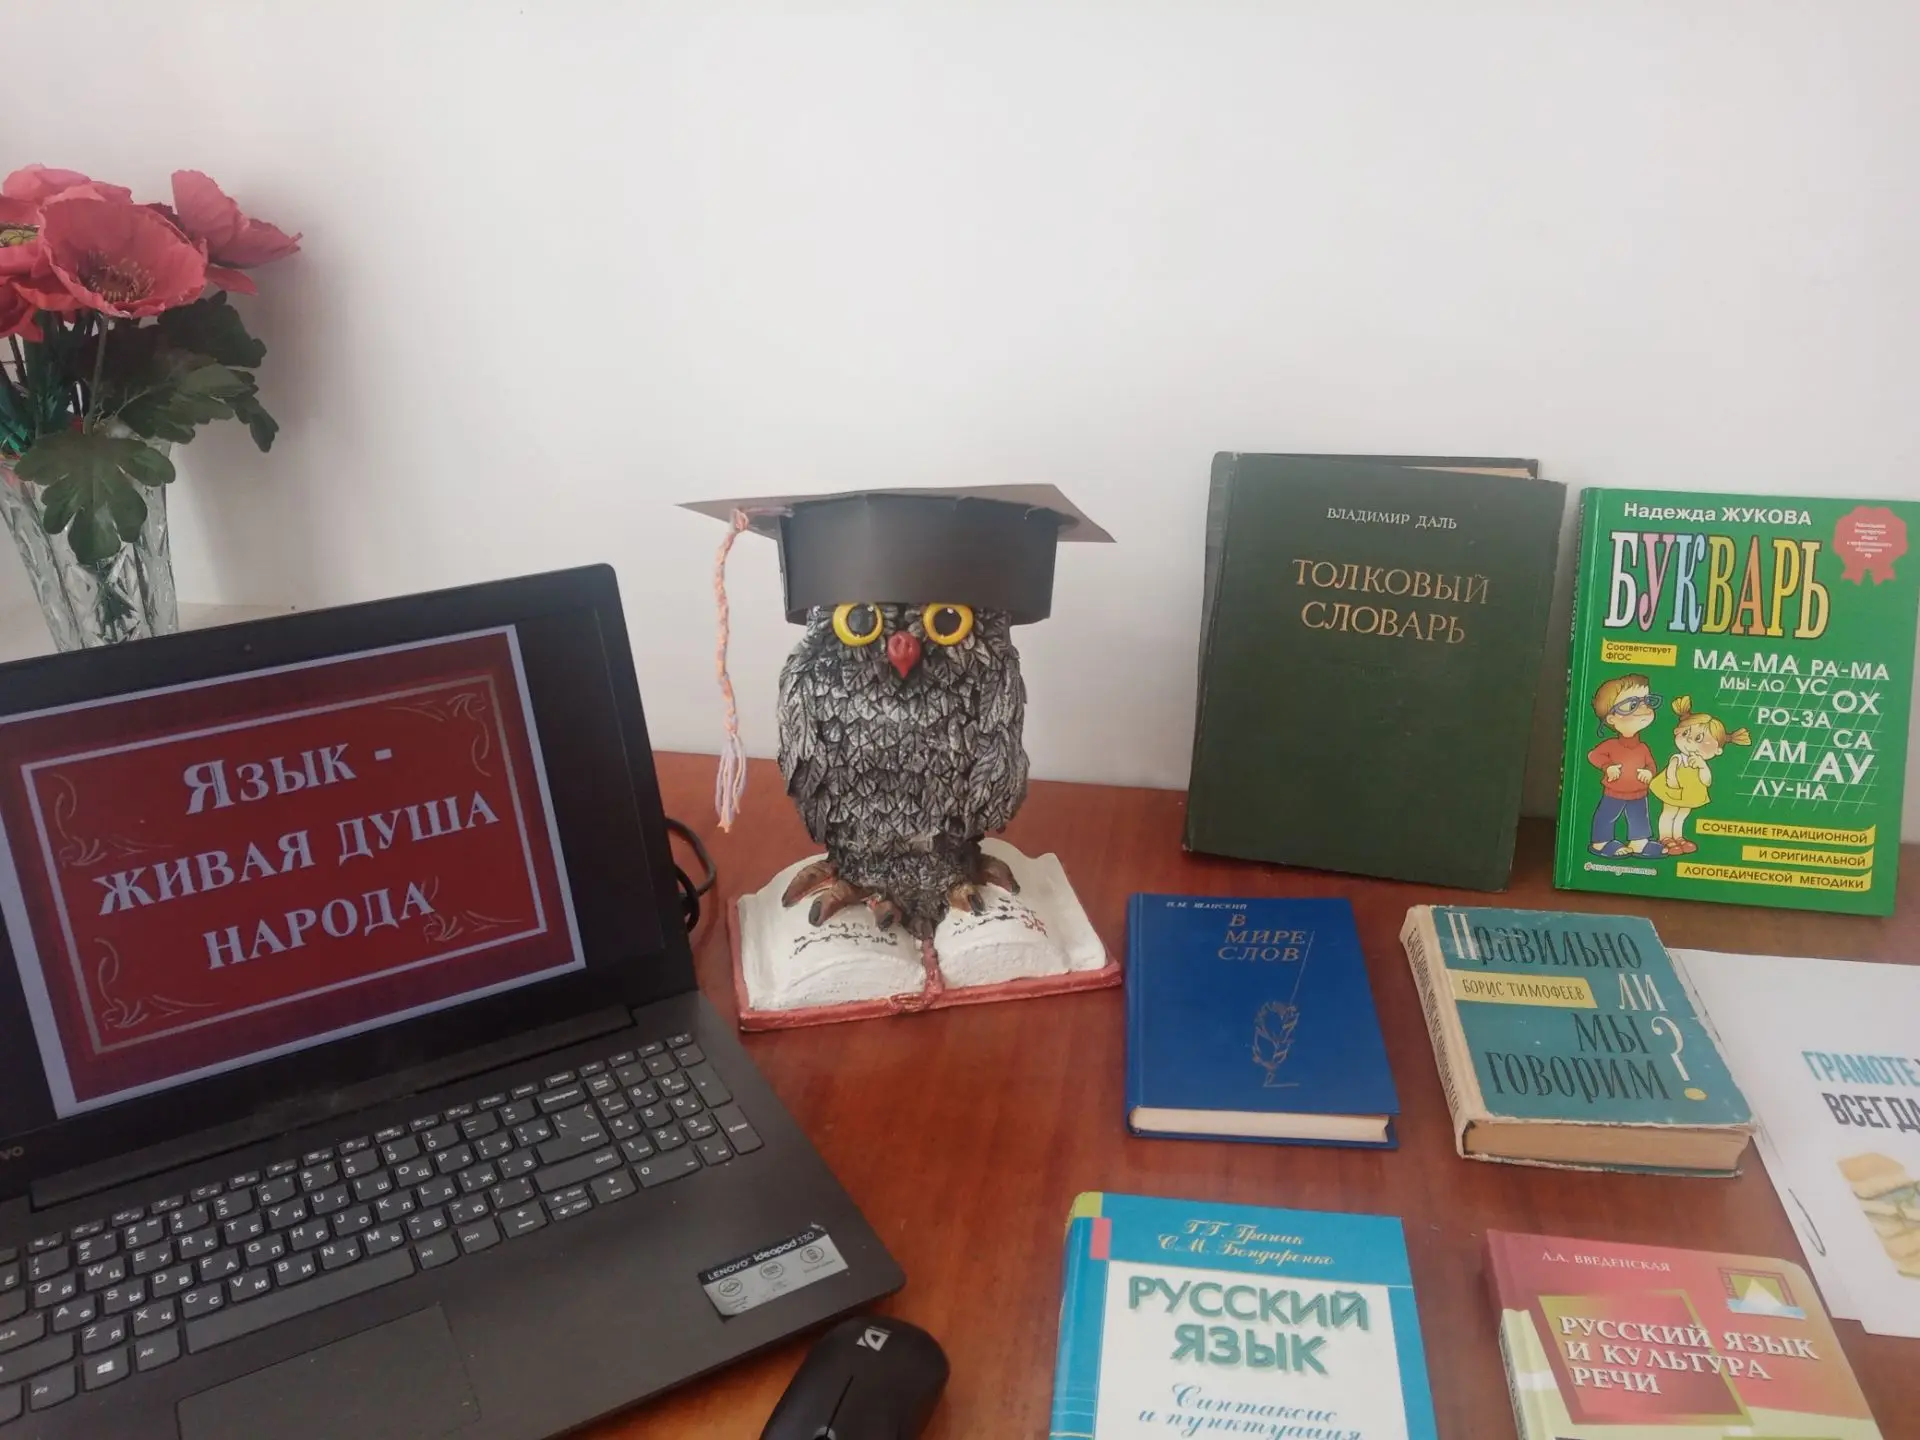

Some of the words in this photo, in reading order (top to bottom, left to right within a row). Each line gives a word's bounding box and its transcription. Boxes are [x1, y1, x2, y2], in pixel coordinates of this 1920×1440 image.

[1327, 508, 1410, 525] ВЛАДИМИР
[1415, 515, 1458, 530] ДАЛЬ
[1624, 503, 1716, 522] Надежда
[1722, 506, 1812, 526] ЖУКОВА
[1292, 559, 1490, 604] ТОЛКОВЫЙ
[1604, 530, 1831, 640] БУКВАРЬ
[1300, 601, 1465, 644] СЛОВАРЬ
[1606, 642, 1672, 655] Соответствует
[1606, 651, 1632, 661] ФГОС
[1693, 649, 1799, 674] МА-МА
[1811, 660, 1890, 681] РА-МА
[1720, 676, 1785, 692] МЫ-ЛО
[1796, 678, 1828, 696] УС
[1832, 690, 1880, 715] ОХ
[1757, 707, 1832, 729] РО-ЗА
[1833, 729, 1872, 749] СА
[1753, 739, 1807, 764] АМ
[1813, 752, 1874, 784] АУ
[1752, 779, 1828, 800] ЛУ-НА
[1702, 823, 1768, 835] СОЧЕТАНИЕ
[1772, 828, 1867, 844] ТРАДИЦИОННОЙ
[93, 831, 315, 916] ЖИВАЯ
[337, 791, 500, 865] ДУША
[1759, 850, 1767, 858] И
[1771, 850, 1866, 867] ОРИГИНАЛЬНОЙ
[1684, 867, 1793, 883] ЛОГОПЕДИЧЕСКОЙ
[1800, 876, 1864, 889] МЕТОДИКИ
[202, 881, 434, 970] НАРОДА
[1229, 913, 1247, 927] В
[1225, 930, 1306, 944] МИРЕ
[1218, 946, 1300, 961] СЛОВ
[1462, 979, 1505, 997] БОРИС
[1506, 982, 1585, 1001] ТИМОФЕЕВ
[1801, 1050, 1920, 1087] ГРАМОТЕ
[633, 1088, 642, 1096] 8
[662, 1078, 671, 1086] 9
[602, 1098, 610, 1106] 7
[615, 1119, 623, 1127] 4
[658, 1131, 667, 1139] 2
[1218, 1239, 1335, 1267] Бондаренко
[1574, 1254, 1671, 1272] ВВЕДЕНСКАЯ
[1128, 1275, 1370, 1331] РУССКИЙ
[1170, 1323, 1329, 1375] ЯЗЫК
[1558, 1315, 1714, 1349] РУССКИЙ
[1723, 1330, 1822, 1361] ЯЗЫК
[1564, 1340, 1590, 1363] И
[1603, 1345, 1773, 1381] КУЛЬТУРА
[1570, 1366, 1663, 1395] РЕЧИ
[1172, 1383, 1338, 1423] Синтаксис
